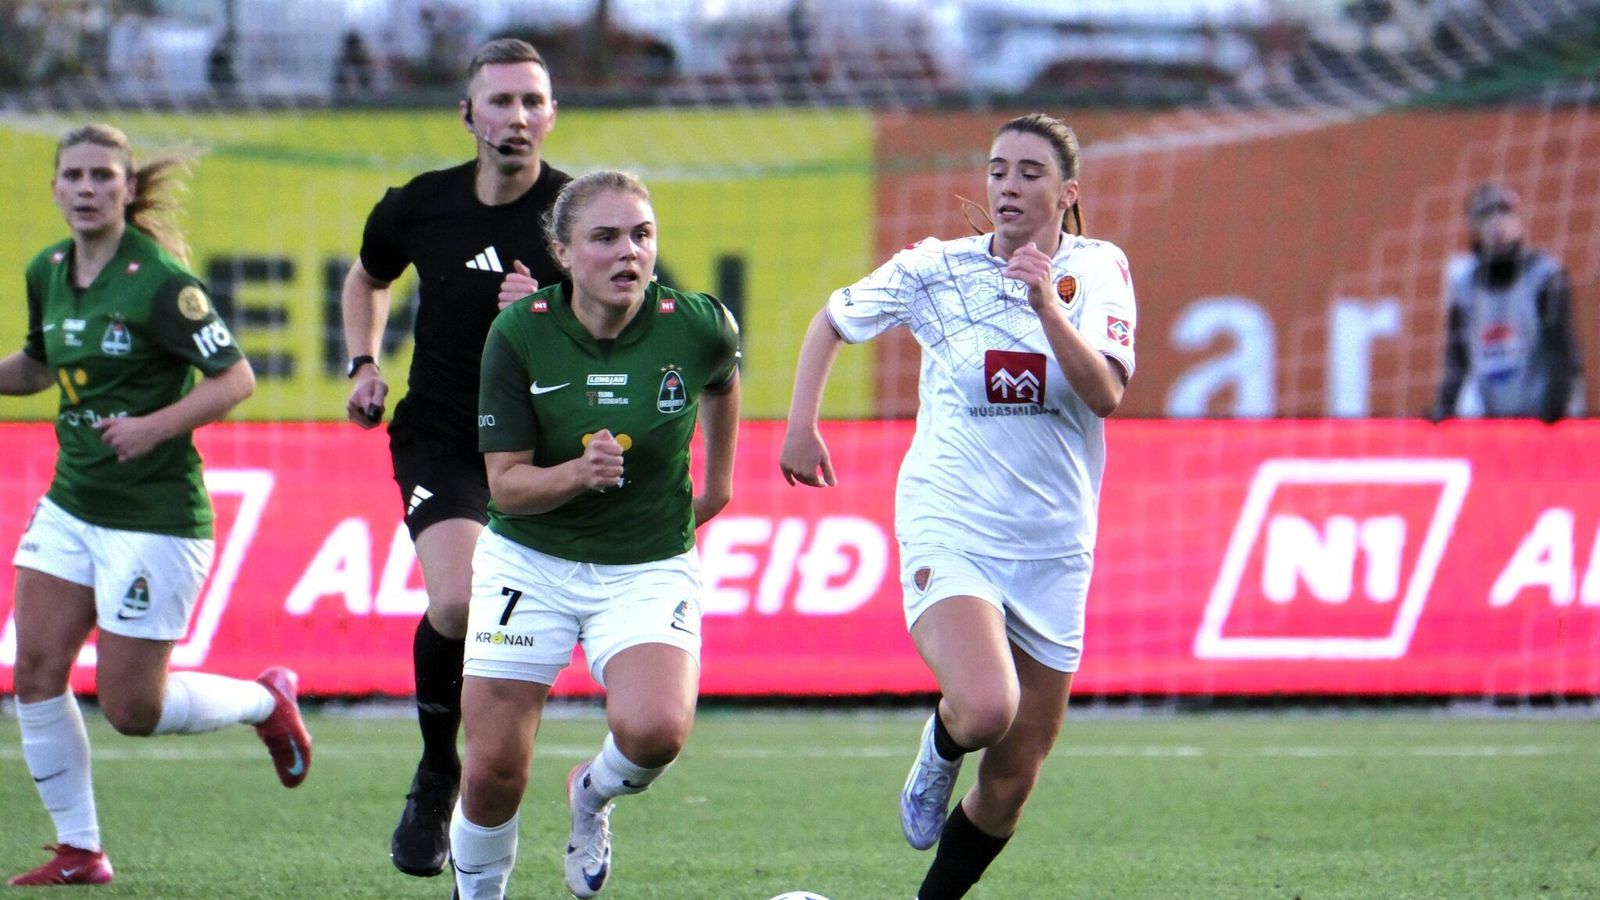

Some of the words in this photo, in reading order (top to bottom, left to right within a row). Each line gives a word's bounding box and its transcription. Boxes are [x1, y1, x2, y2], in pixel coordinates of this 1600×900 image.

[697, 516, 888, 614] EIÐ
[1262, 514, 1407, 604] N1
[499, 586, 522, 626] 7
